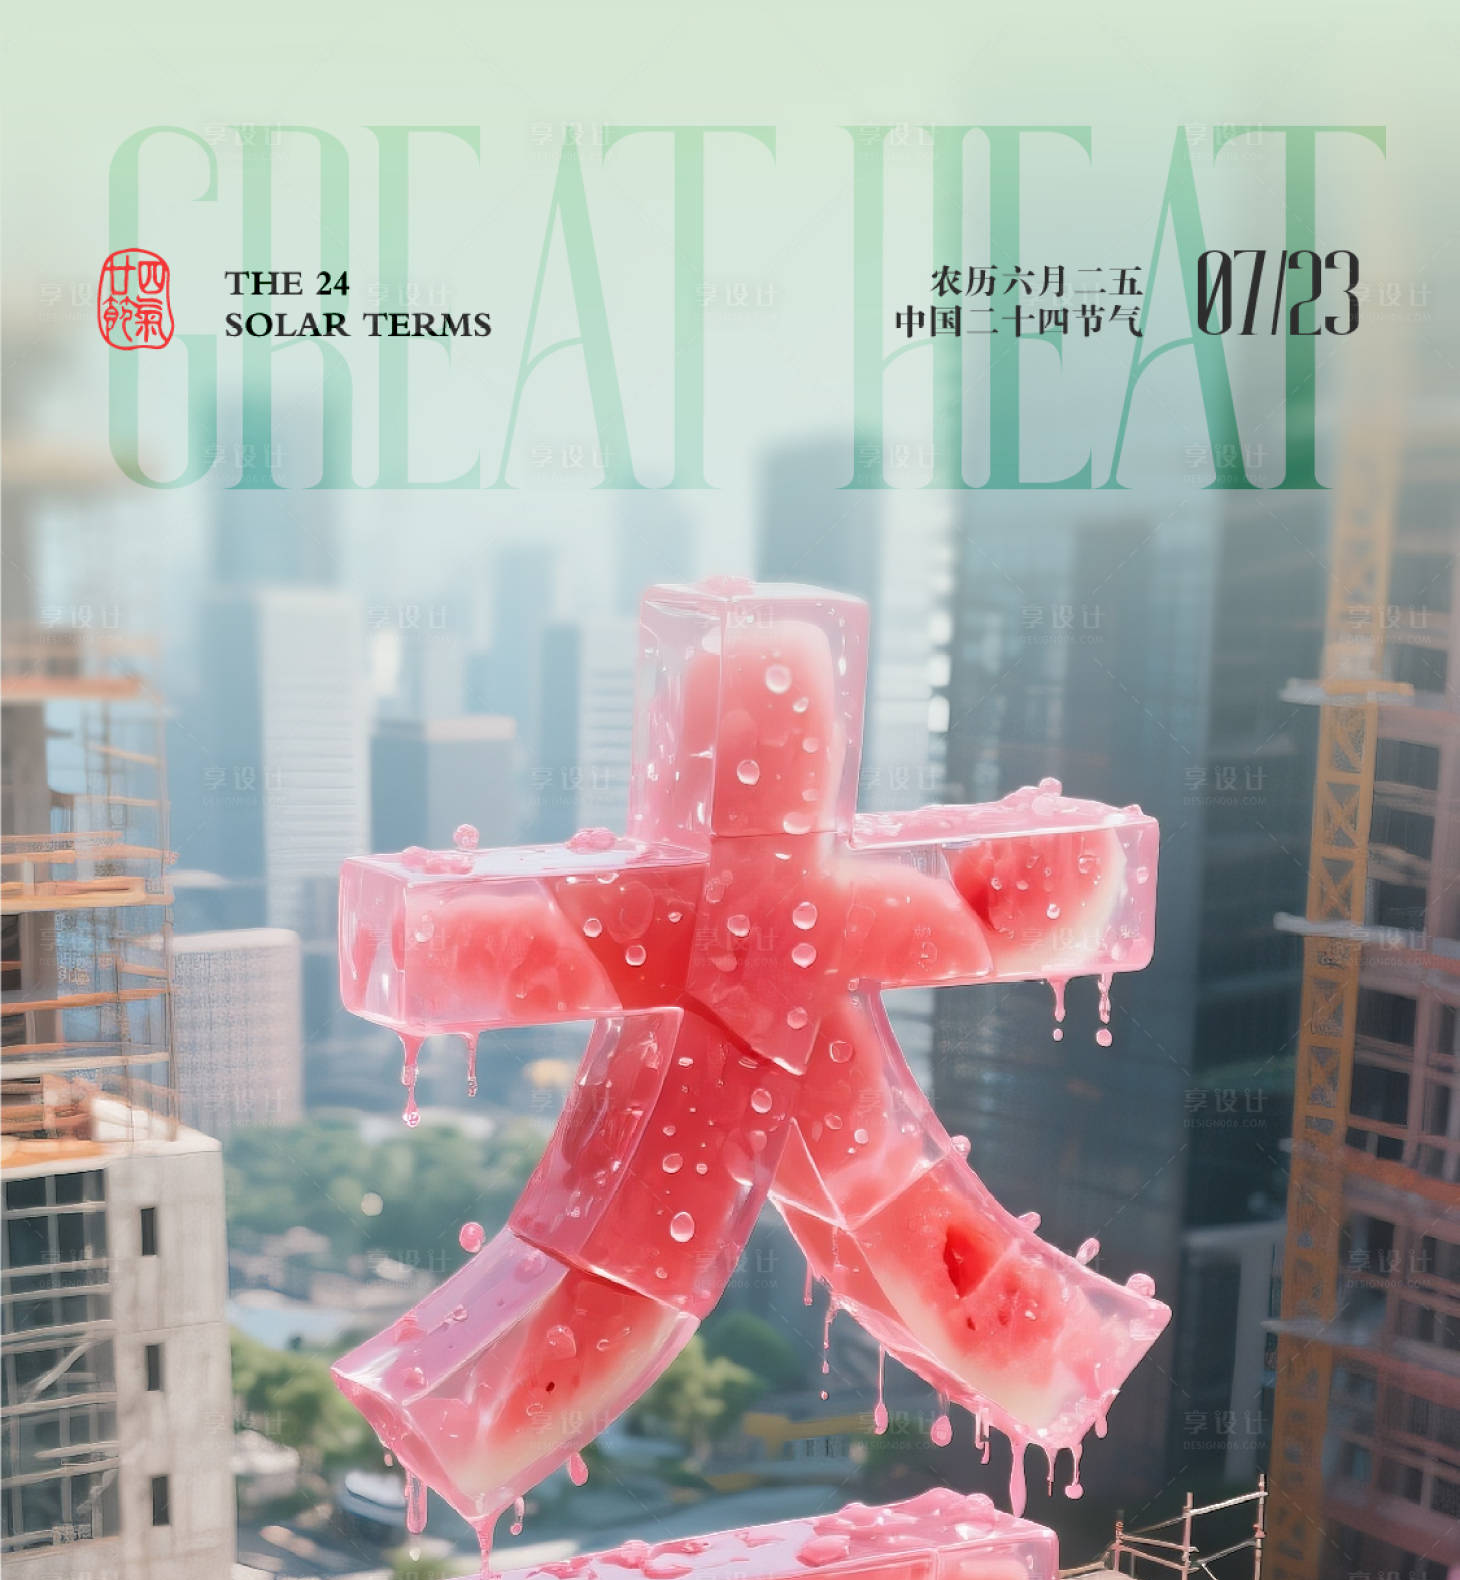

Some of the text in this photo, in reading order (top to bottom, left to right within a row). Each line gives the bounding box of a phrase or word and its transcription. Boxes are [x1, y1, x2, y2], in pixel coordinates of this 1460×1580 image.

[224, 270, 350, 296] THE 24
[931, 264, 1144, 298] 农历六月二五
[1197, 249, 1359, 336] 07/23
[108, 126, 1388, 490] GREAT HEAT
[225, 312, 492, 337] SOLAR TERMS
[895, 304, 1144, 338] 中国二十四节气
